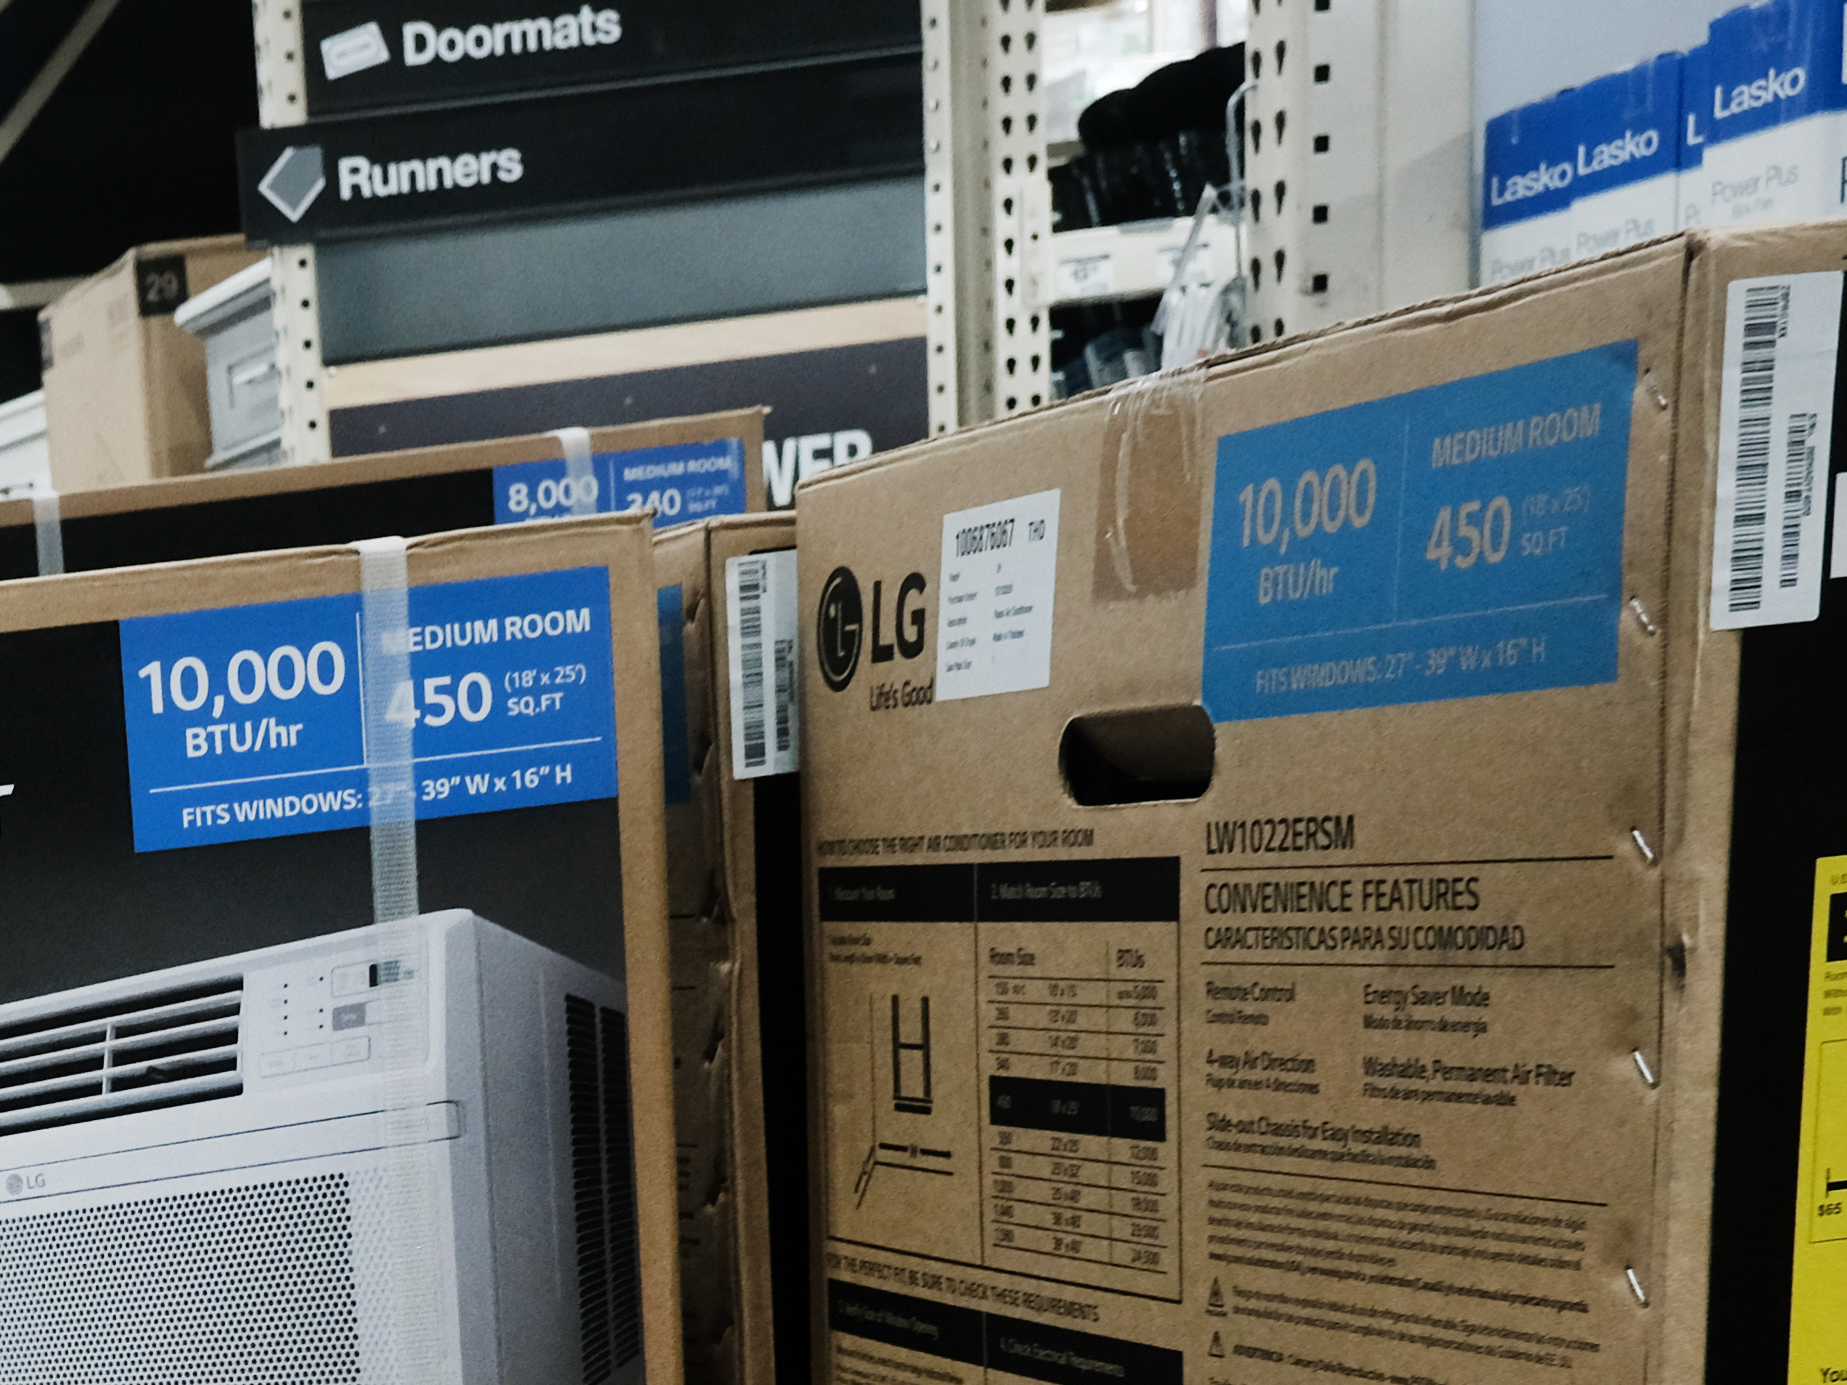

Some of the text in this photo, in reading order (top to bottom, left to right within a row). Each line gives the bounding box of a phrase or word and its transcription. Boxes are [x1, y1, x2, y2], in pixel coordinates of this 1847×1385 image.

[402, 4, 622, 67] Doormats
[1713, 67, 1806, 119] Lasko
[1577, 129, 1660, 176] Lasko
[338, 148, 524, 201] Runners
[1490, 162, 1574, 206] Lasko
[624, 456, 732, 482] MEDIUM ROOM
[508, 476, 599, 514] 8,000
[1239, 457, 1378, 555] 10,000
[1027, 518, 1046, 543] THD
[1426, 495, 1512, 571] 450
[1258, 562, 1341, 604] BTU/hr
[870, 572, 927, 664] LG
[138, 641, 346, 719] 10,000
[385, 671, 494, 729] 450
[507, 693, 565, 717] SQ.FT
[185, 719, 303, 759] BTU/hr
[1206, 814, 1355, 857] LW1022ERSM
[1205, 875, 1481, 916] CONVENIENCE FEATURES
[1205, 924, 1526, 952] CARACTERISTICAS PARA SU COMODIDAD
[1363, 984, 1491, 1012] Energy Saver Mode
[26, 1173, 47, 1189] LG
[1817, 1201, 1842, 1216] $65
